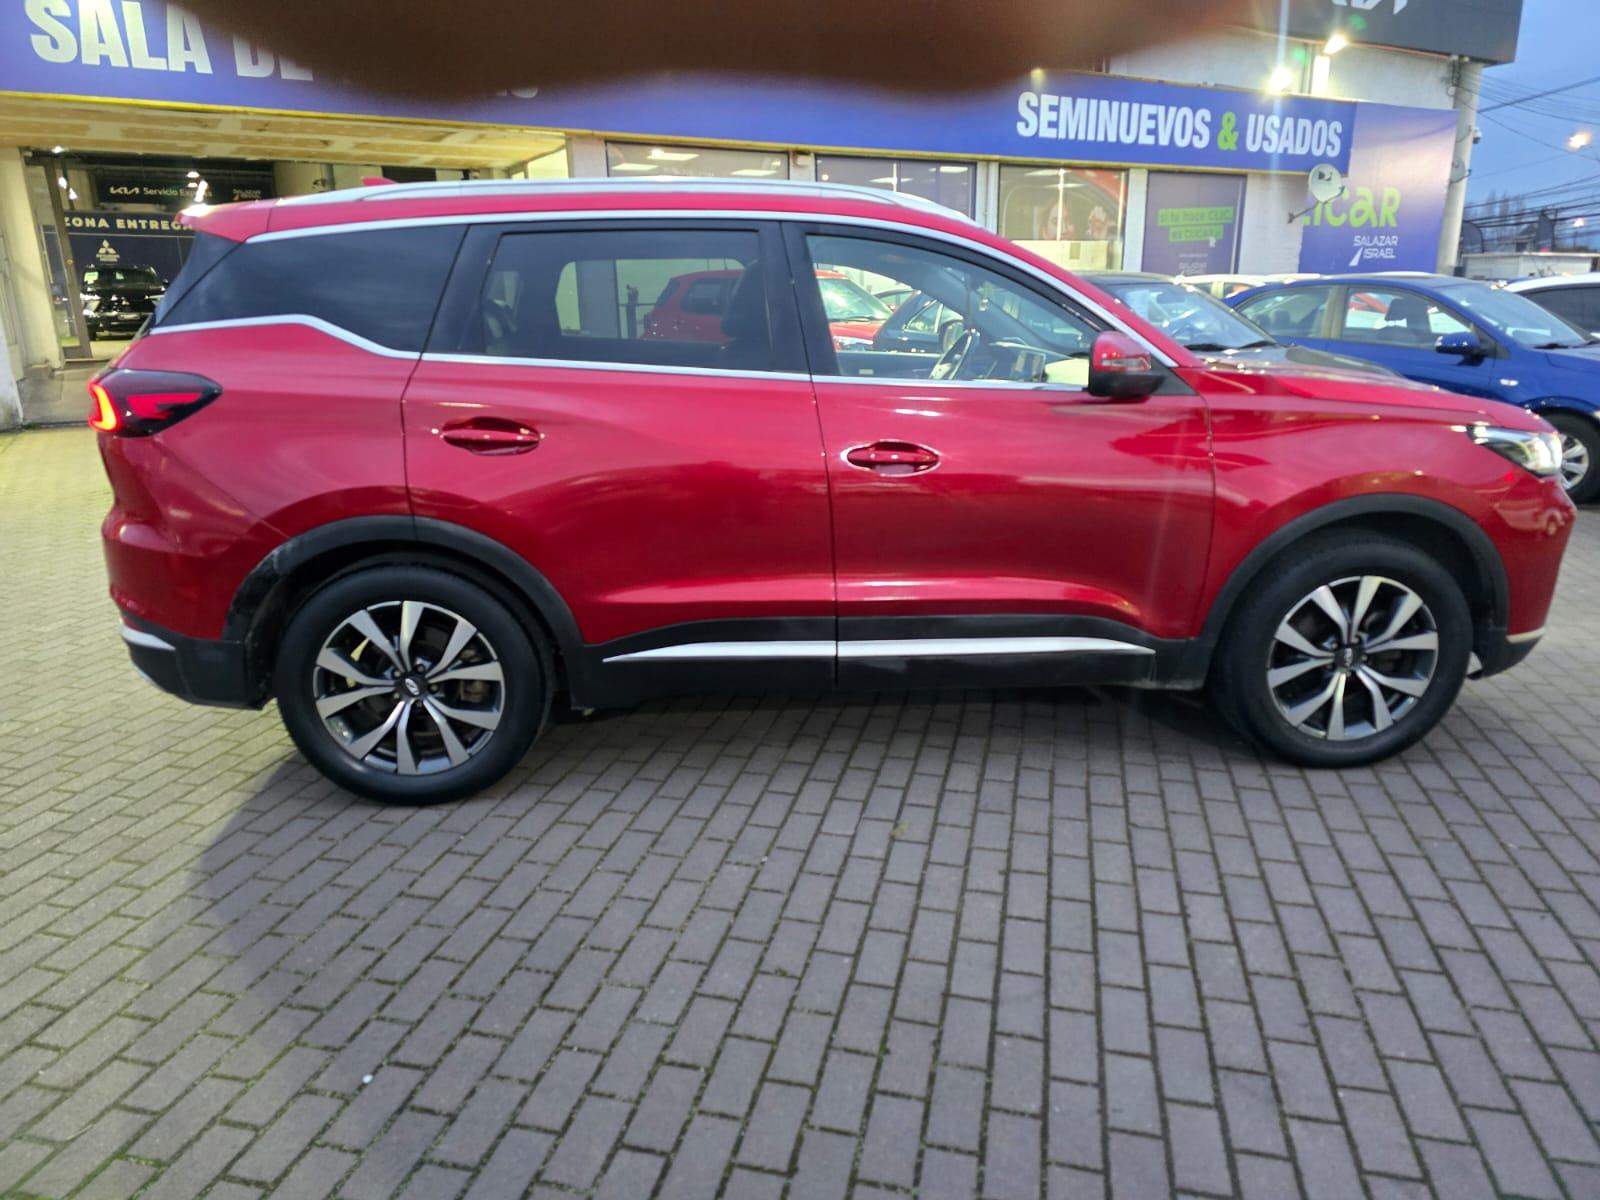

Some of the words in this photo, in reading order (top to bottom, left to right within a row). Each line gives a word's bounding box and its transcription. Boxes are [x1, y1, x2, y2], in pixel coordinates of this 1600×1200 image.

[24, 0, 213, 74] SALA
[1016, 91, 1212, 149] SEMINUEVOS
[1216, 111, 1239, 150] &
[1245, 113, 1343, 157] USADOS
[143, 187, 178, 196] Servicio
[1353, 235, 1398, 247] SALAZAR
[1363, 247, 1396, 259] ISRAEL
